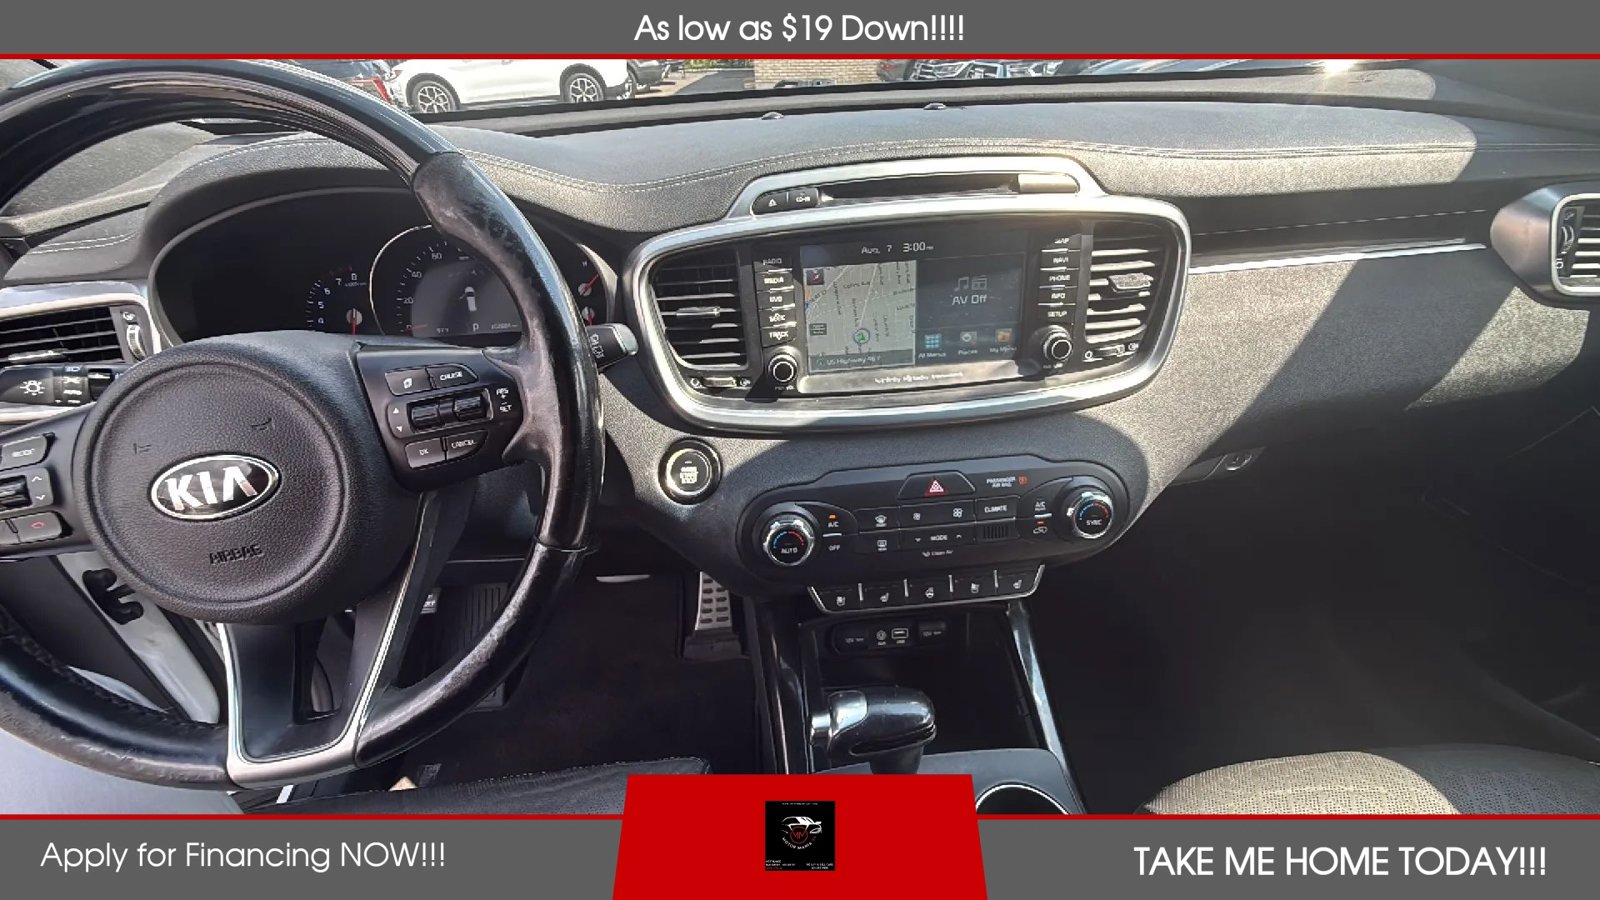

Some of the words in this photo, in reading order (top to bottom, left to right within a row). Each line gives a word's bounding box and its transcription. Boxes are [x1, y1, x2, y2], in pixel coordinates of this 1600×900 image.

[886, 244, 893, 252] 7
[902, 241, 926, 252] 3:00
[335, 278, 342, 286] 7
[1049, 274, 1071, 282] PHONE
[404, 296, 414, 304] 20
[952, 295, 968, 306] AV
[971, 294, 988, 304] Off
[317, 301, 324, 310] 5
[472, 322, 480, 333] P
[440, 371, 463, 381] CRUISE
[419, 448, 429, 456] OK
[165, 465, 258, 511] KIA
[984, 504, 1008, 513] CLIMATE
[209, 544, 264, 565] AIRBAG
